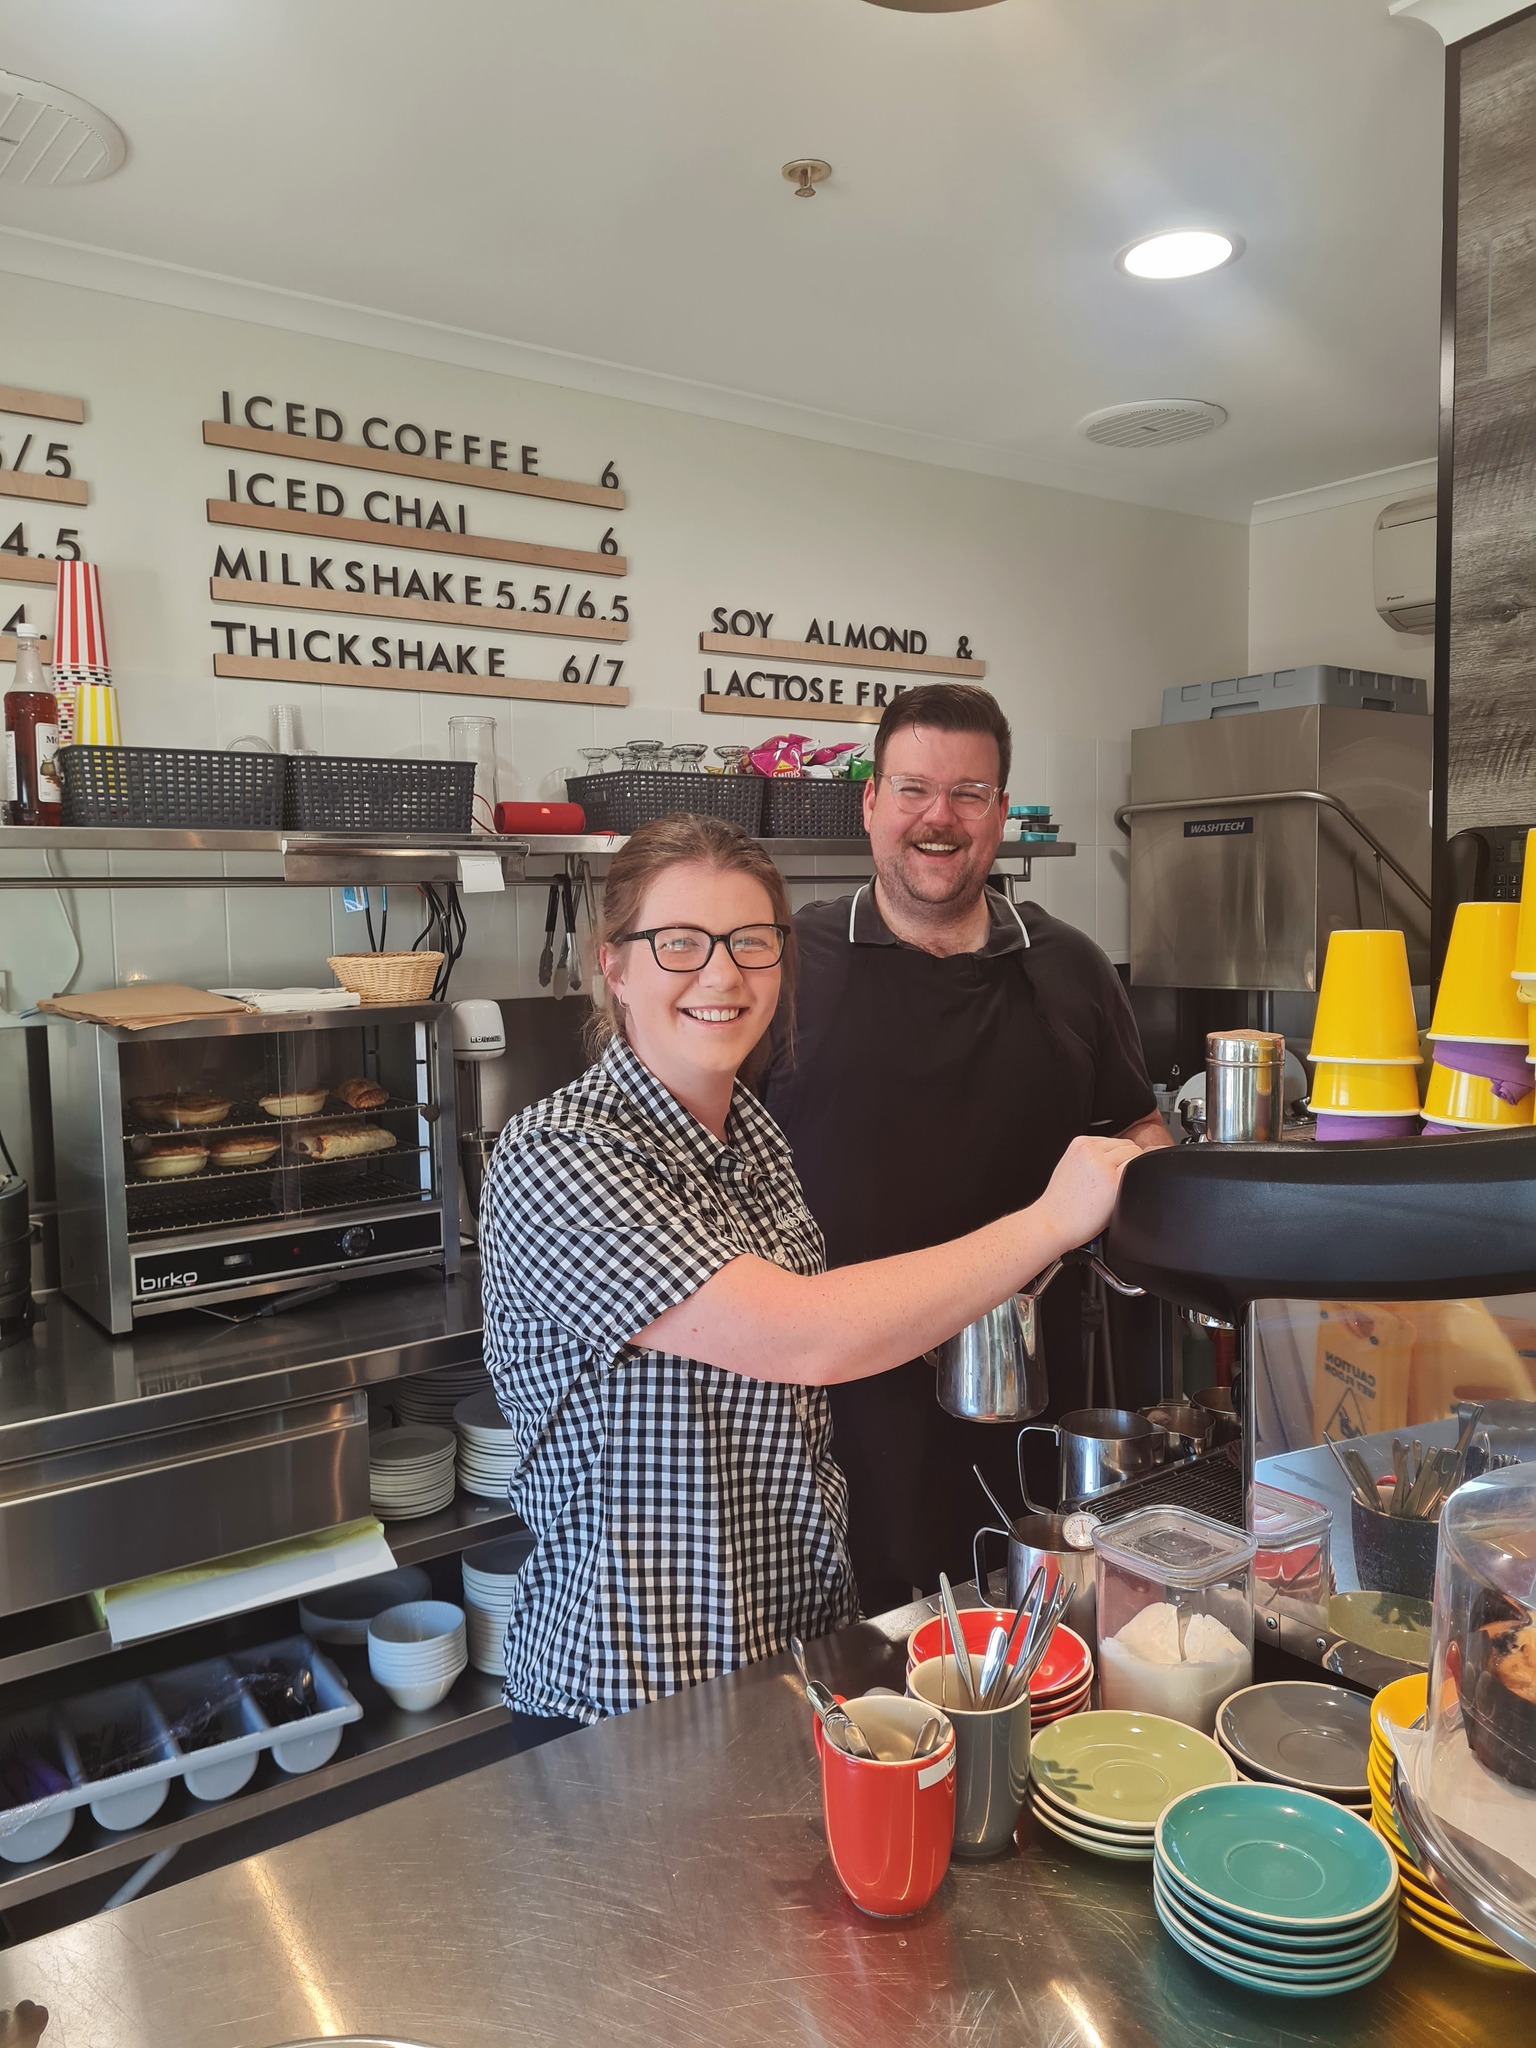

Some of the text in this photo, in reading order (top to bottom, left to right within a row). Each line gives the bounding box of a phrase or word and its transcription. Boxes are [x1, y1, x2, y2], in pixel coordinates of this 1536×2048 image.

[0, 433, 72, 479] /5
[222, 390, 619, 489] ICED COFFEE 6
[228, 469, 618, 555] ICED CHAI 6
[0, 521, 81, 561] 4.5
[213, 544, 629, 622] MILKSHAKE 5.5/6.5
[211, 620, 624, 686] THICKSHAKE 6/7
[712, 606, 973, 660] SOY ALMOND &
[705, 667, 920, 708] LACTOSE FRE
[1190, 821, 1245, 834] WASHTECH
[140, 1271, 198, 1291] birko
